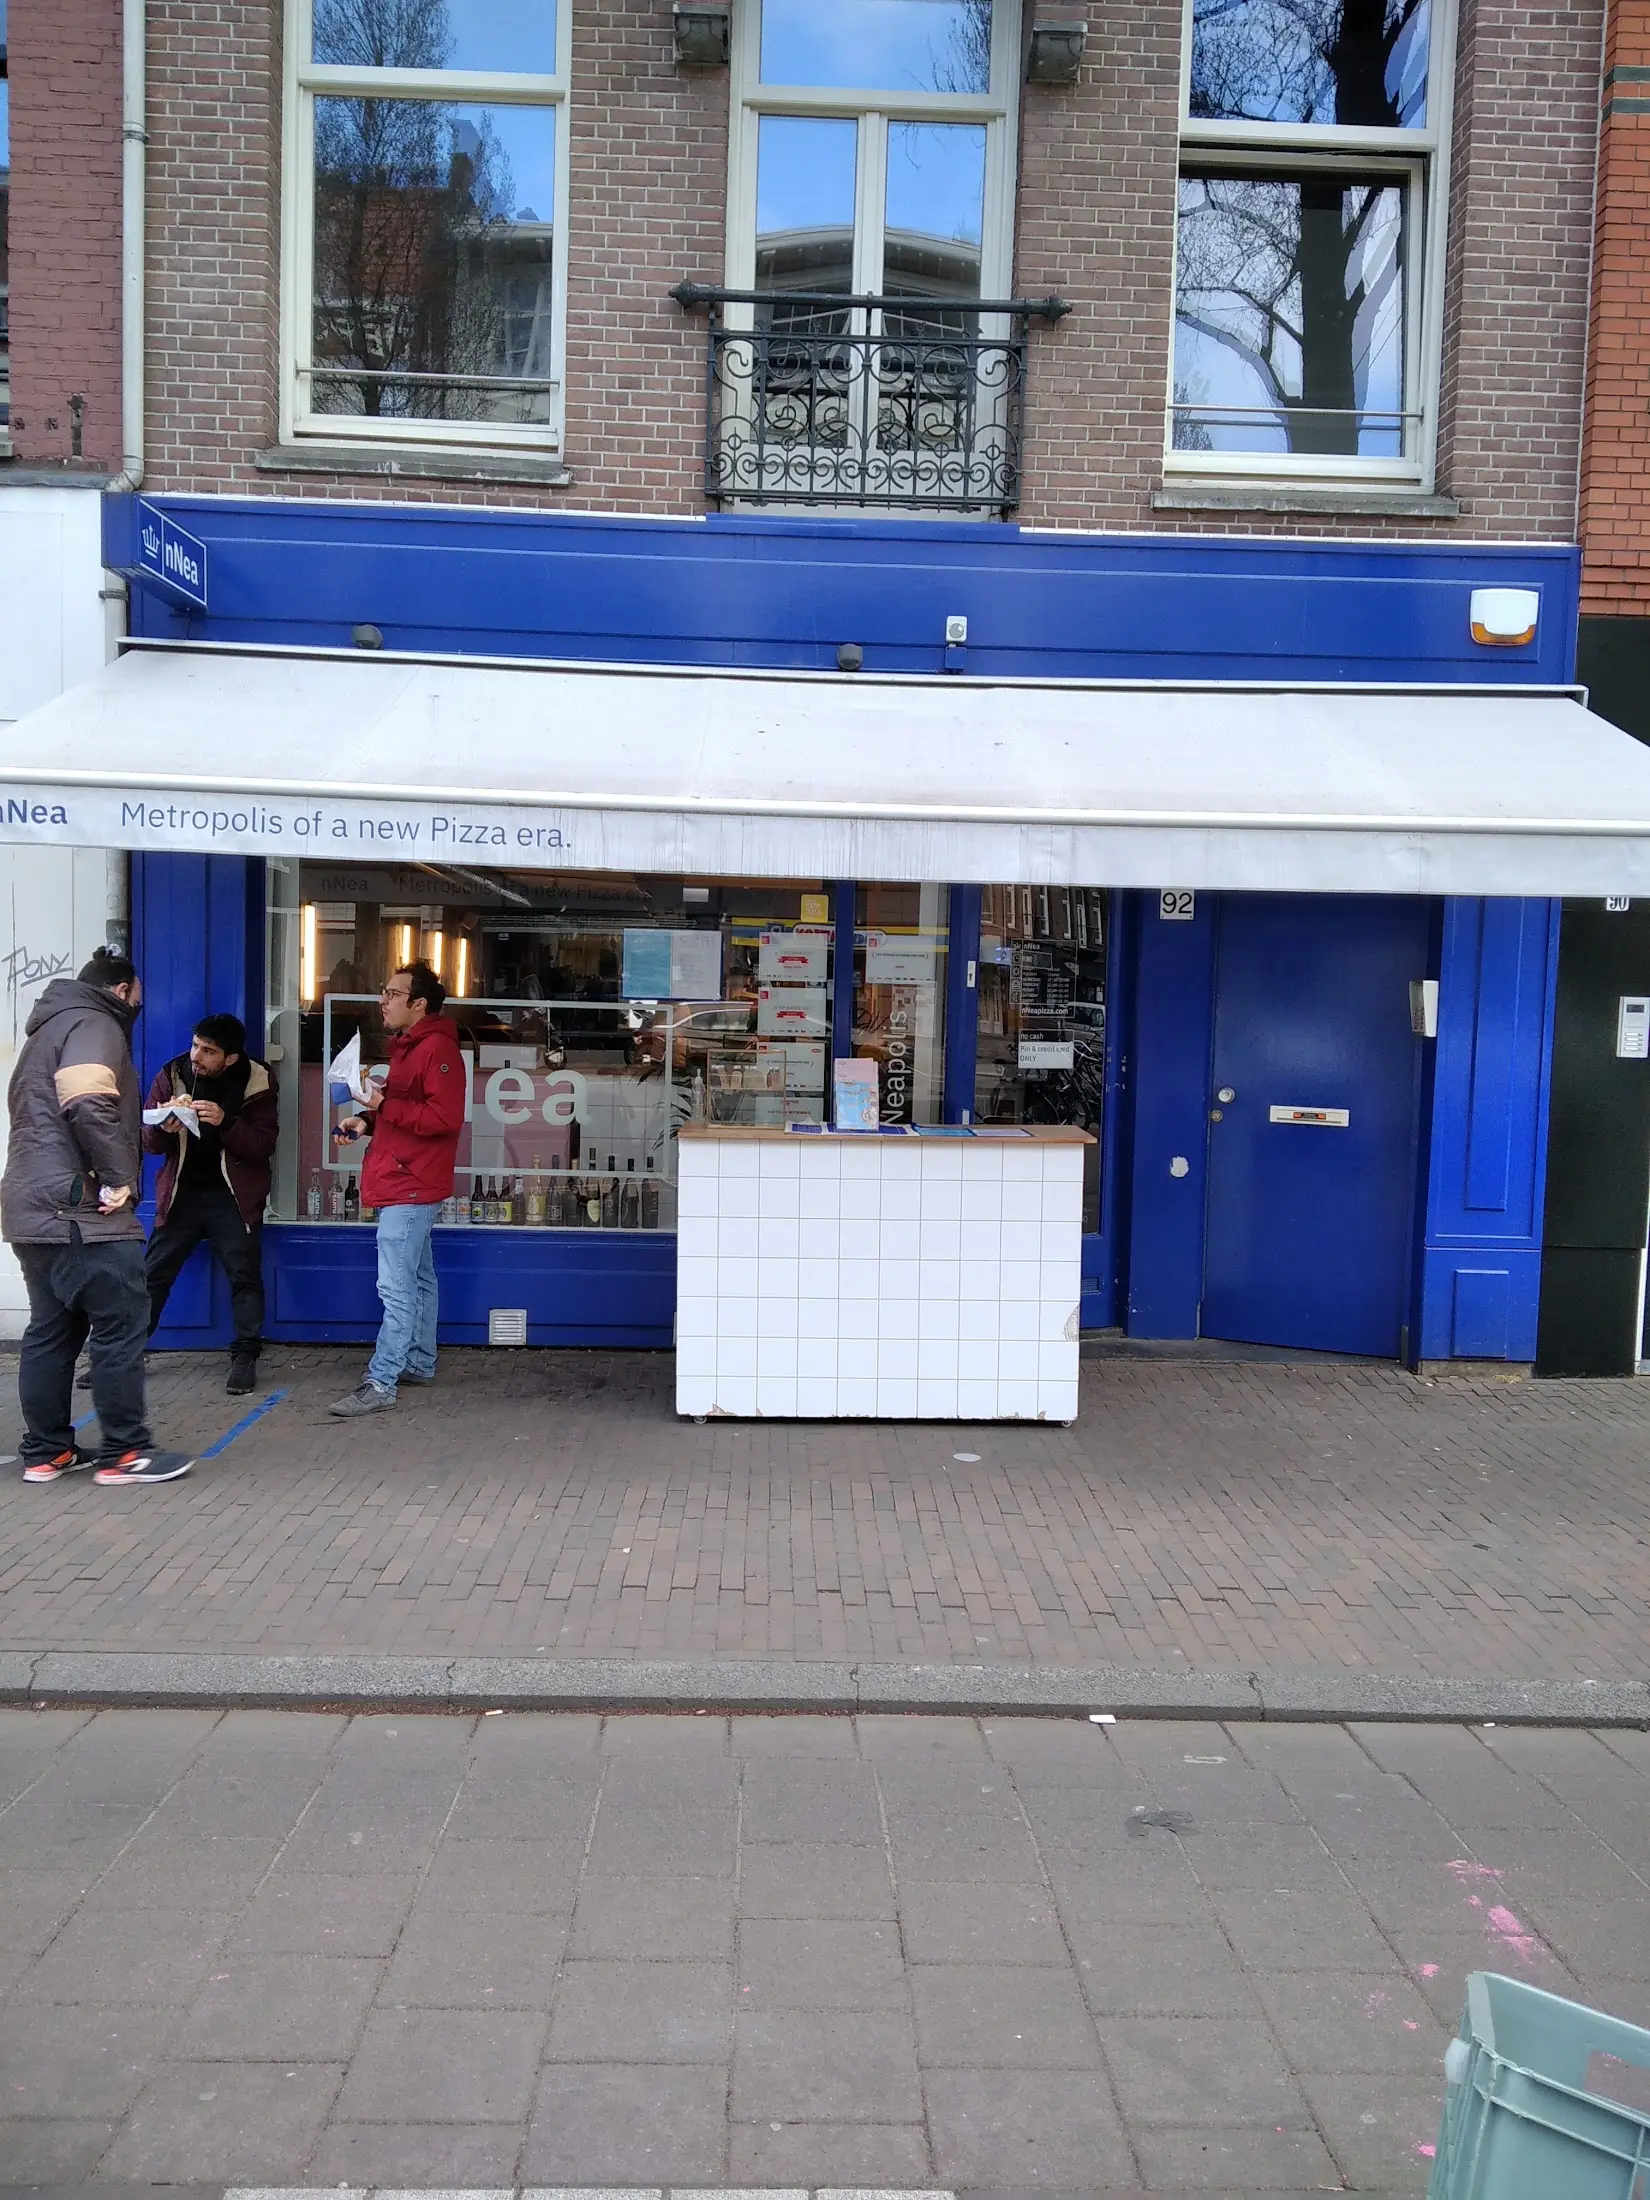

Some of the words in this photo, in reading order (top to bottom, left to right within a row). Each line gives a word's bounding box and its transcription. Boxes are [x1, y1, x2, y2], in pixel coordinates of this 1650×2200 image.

[165, 541, 199, 587] nNea
[121, 801, 283, 837] Metropolis
[293, 811, 323, 837] of
[331, 820, 349, 838] a
[359, 820, 421, 841] new
[431, 816, 507, 846] Pizza
[516, 826, 572, 848] era.
[1162, 891, 1193, 914] 92
[1609, 896, 1628, 910] 90
[1021, 1006, 1069, 1015] nNeapizza.com
[1029, 1032, 1044, 1040] cash
[1037, 1045, 1056, 1053] credit
